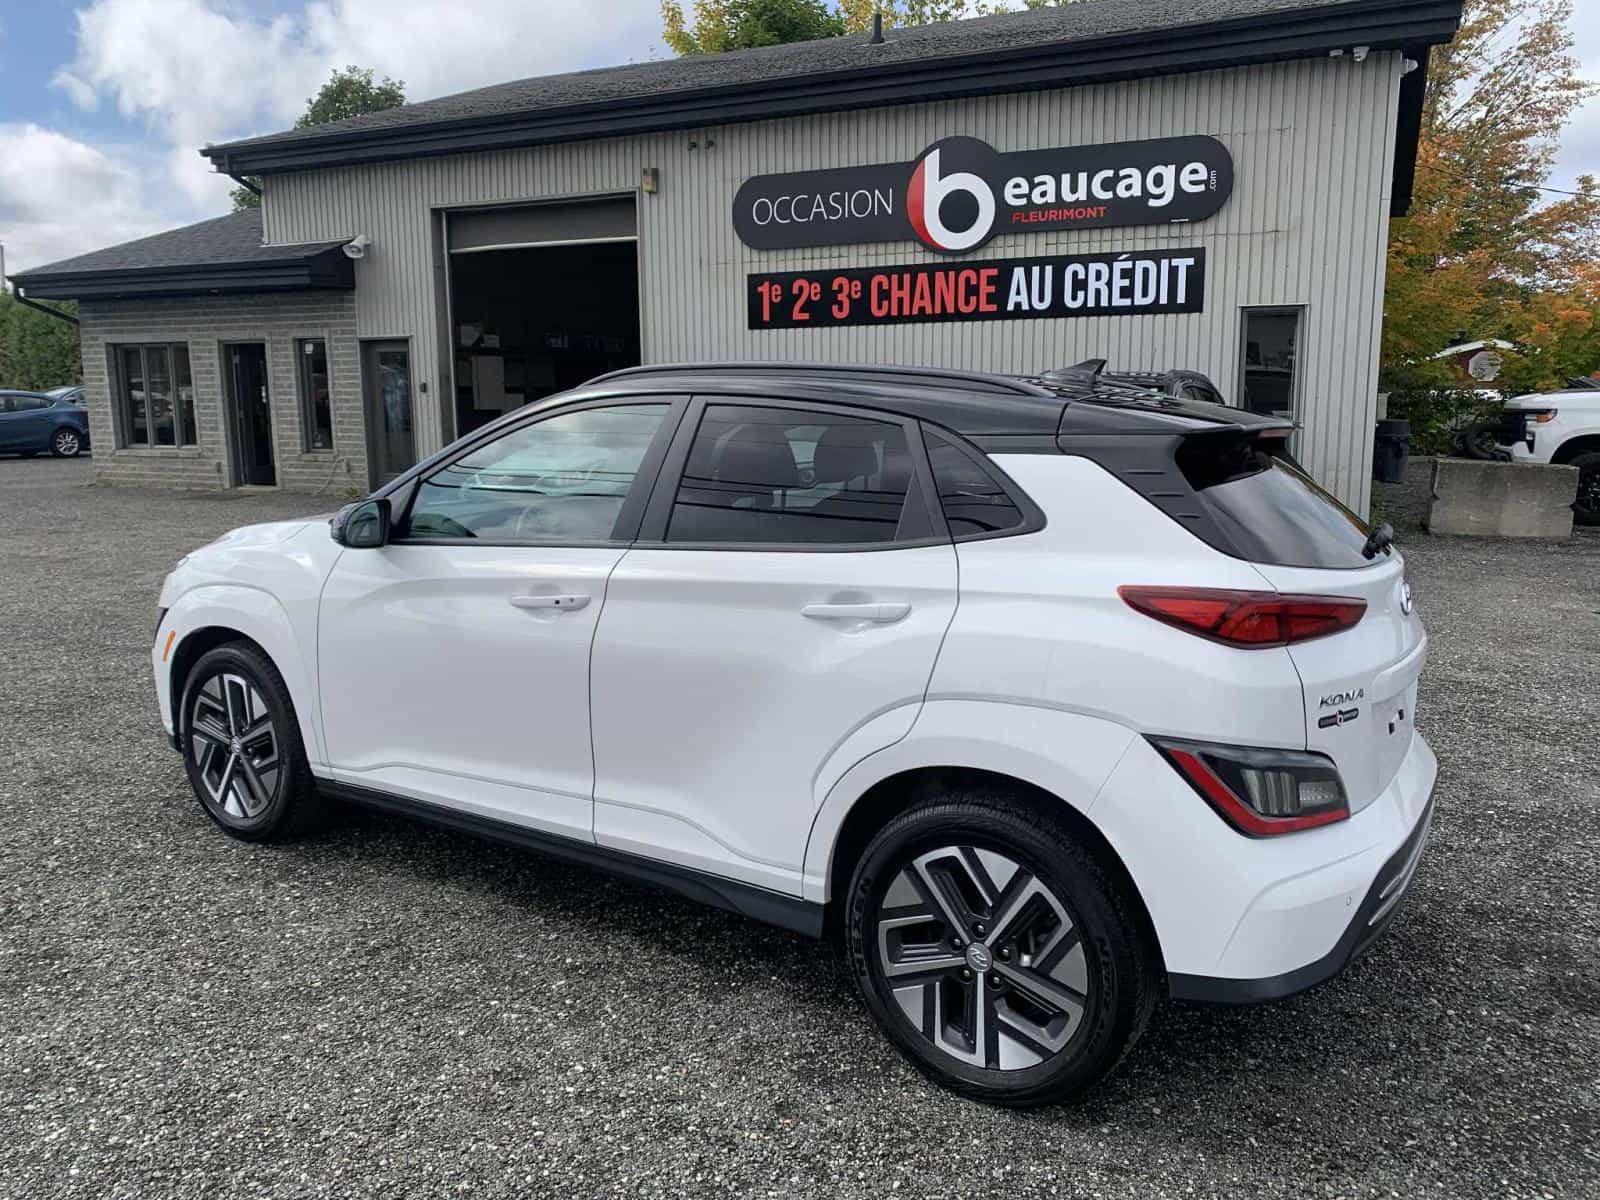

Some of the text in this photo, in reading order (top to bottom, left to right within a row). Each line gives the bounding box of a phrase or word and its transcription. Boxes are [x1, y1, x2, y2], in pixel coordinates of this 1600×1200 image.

[752, 187, 893, 225] OCCASION
[1011, 206, 1107, 224] FLEURIMONT
[870, 268, 999, 318] CHANCE
[1006, 265, 1053, 311] AU
[1063, 254, 1195, 309] CRÉDIT
[1319, 688, 1364, 708] KONA
